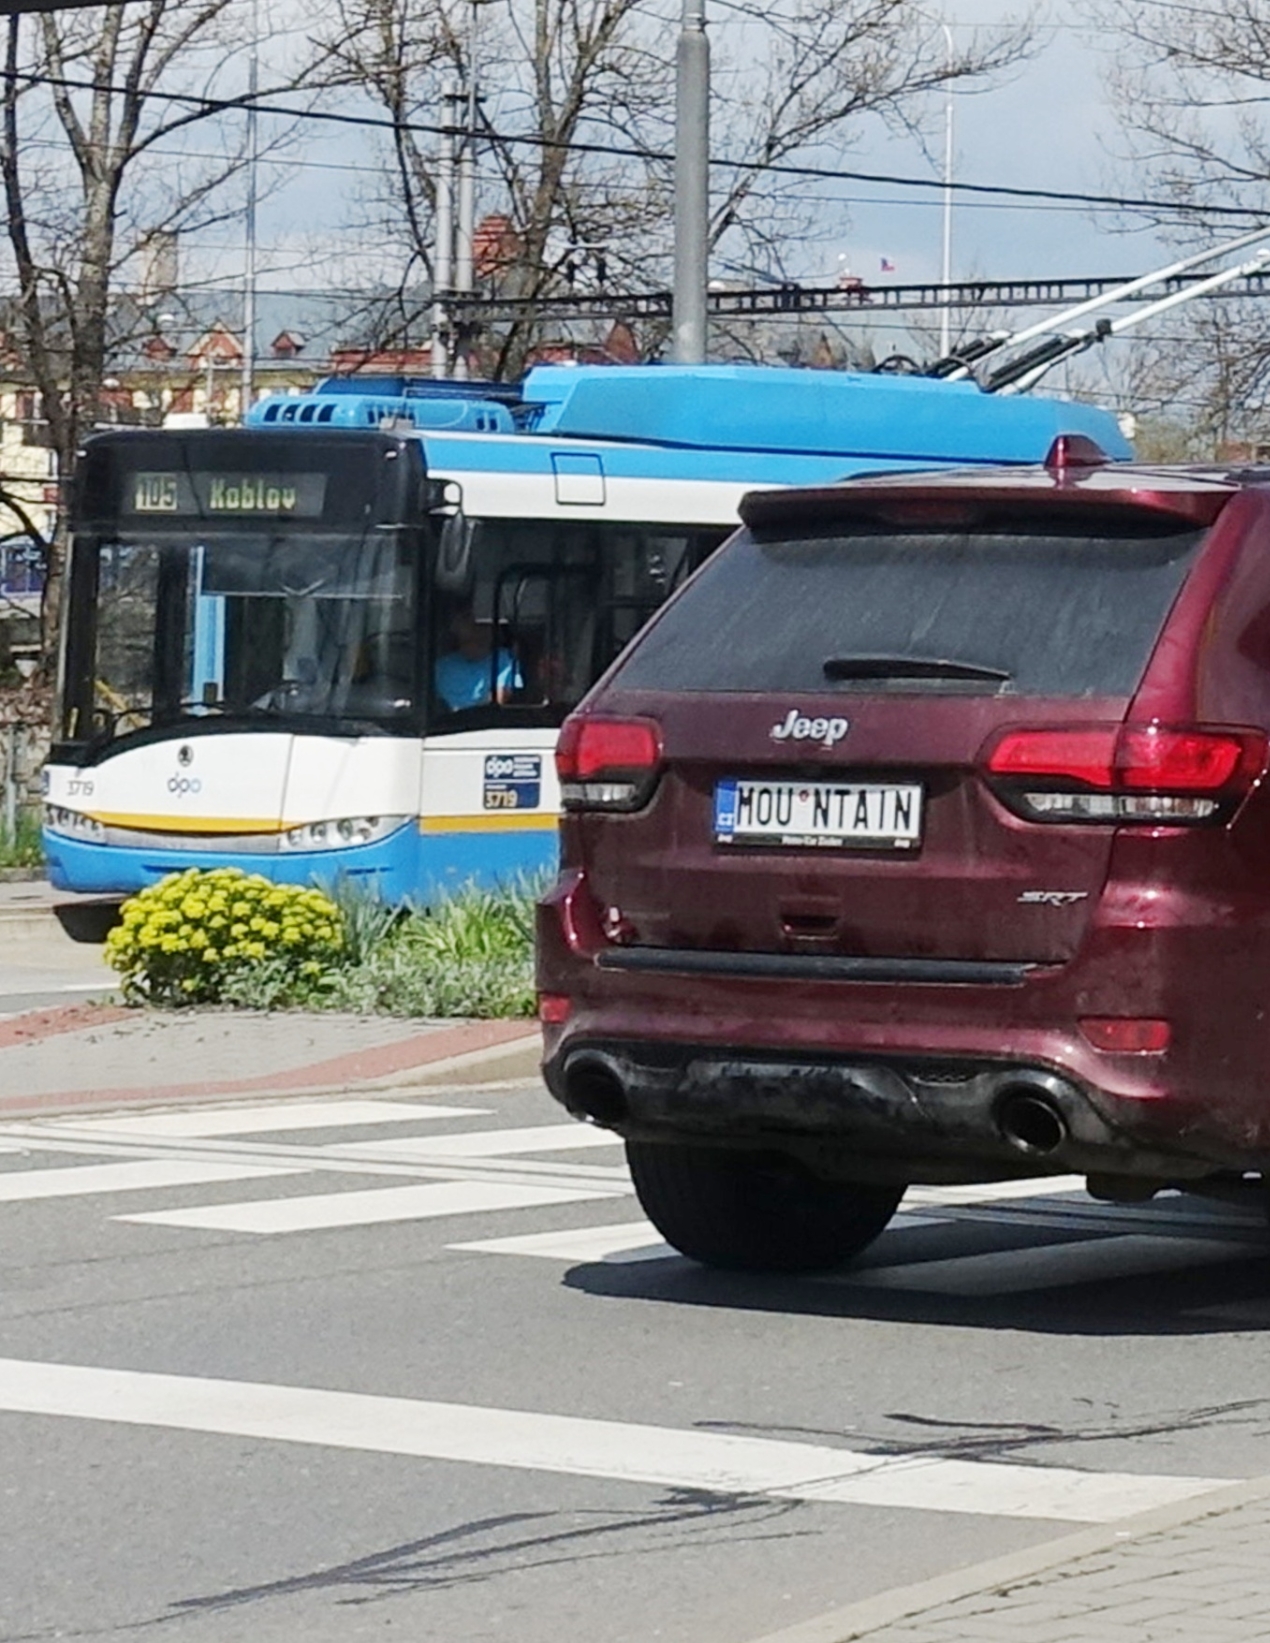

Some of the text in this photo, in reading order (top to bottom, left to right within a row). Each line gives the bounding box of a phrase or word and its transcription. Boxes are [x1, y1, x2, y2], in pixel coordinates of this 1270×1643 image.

[136, 473, 298, 510] 105 Koblov
[772, 709, 848, 746] Jeep
[485, 789, 518, 808] 3719
[1017, 891, 1088, 906] SRT
